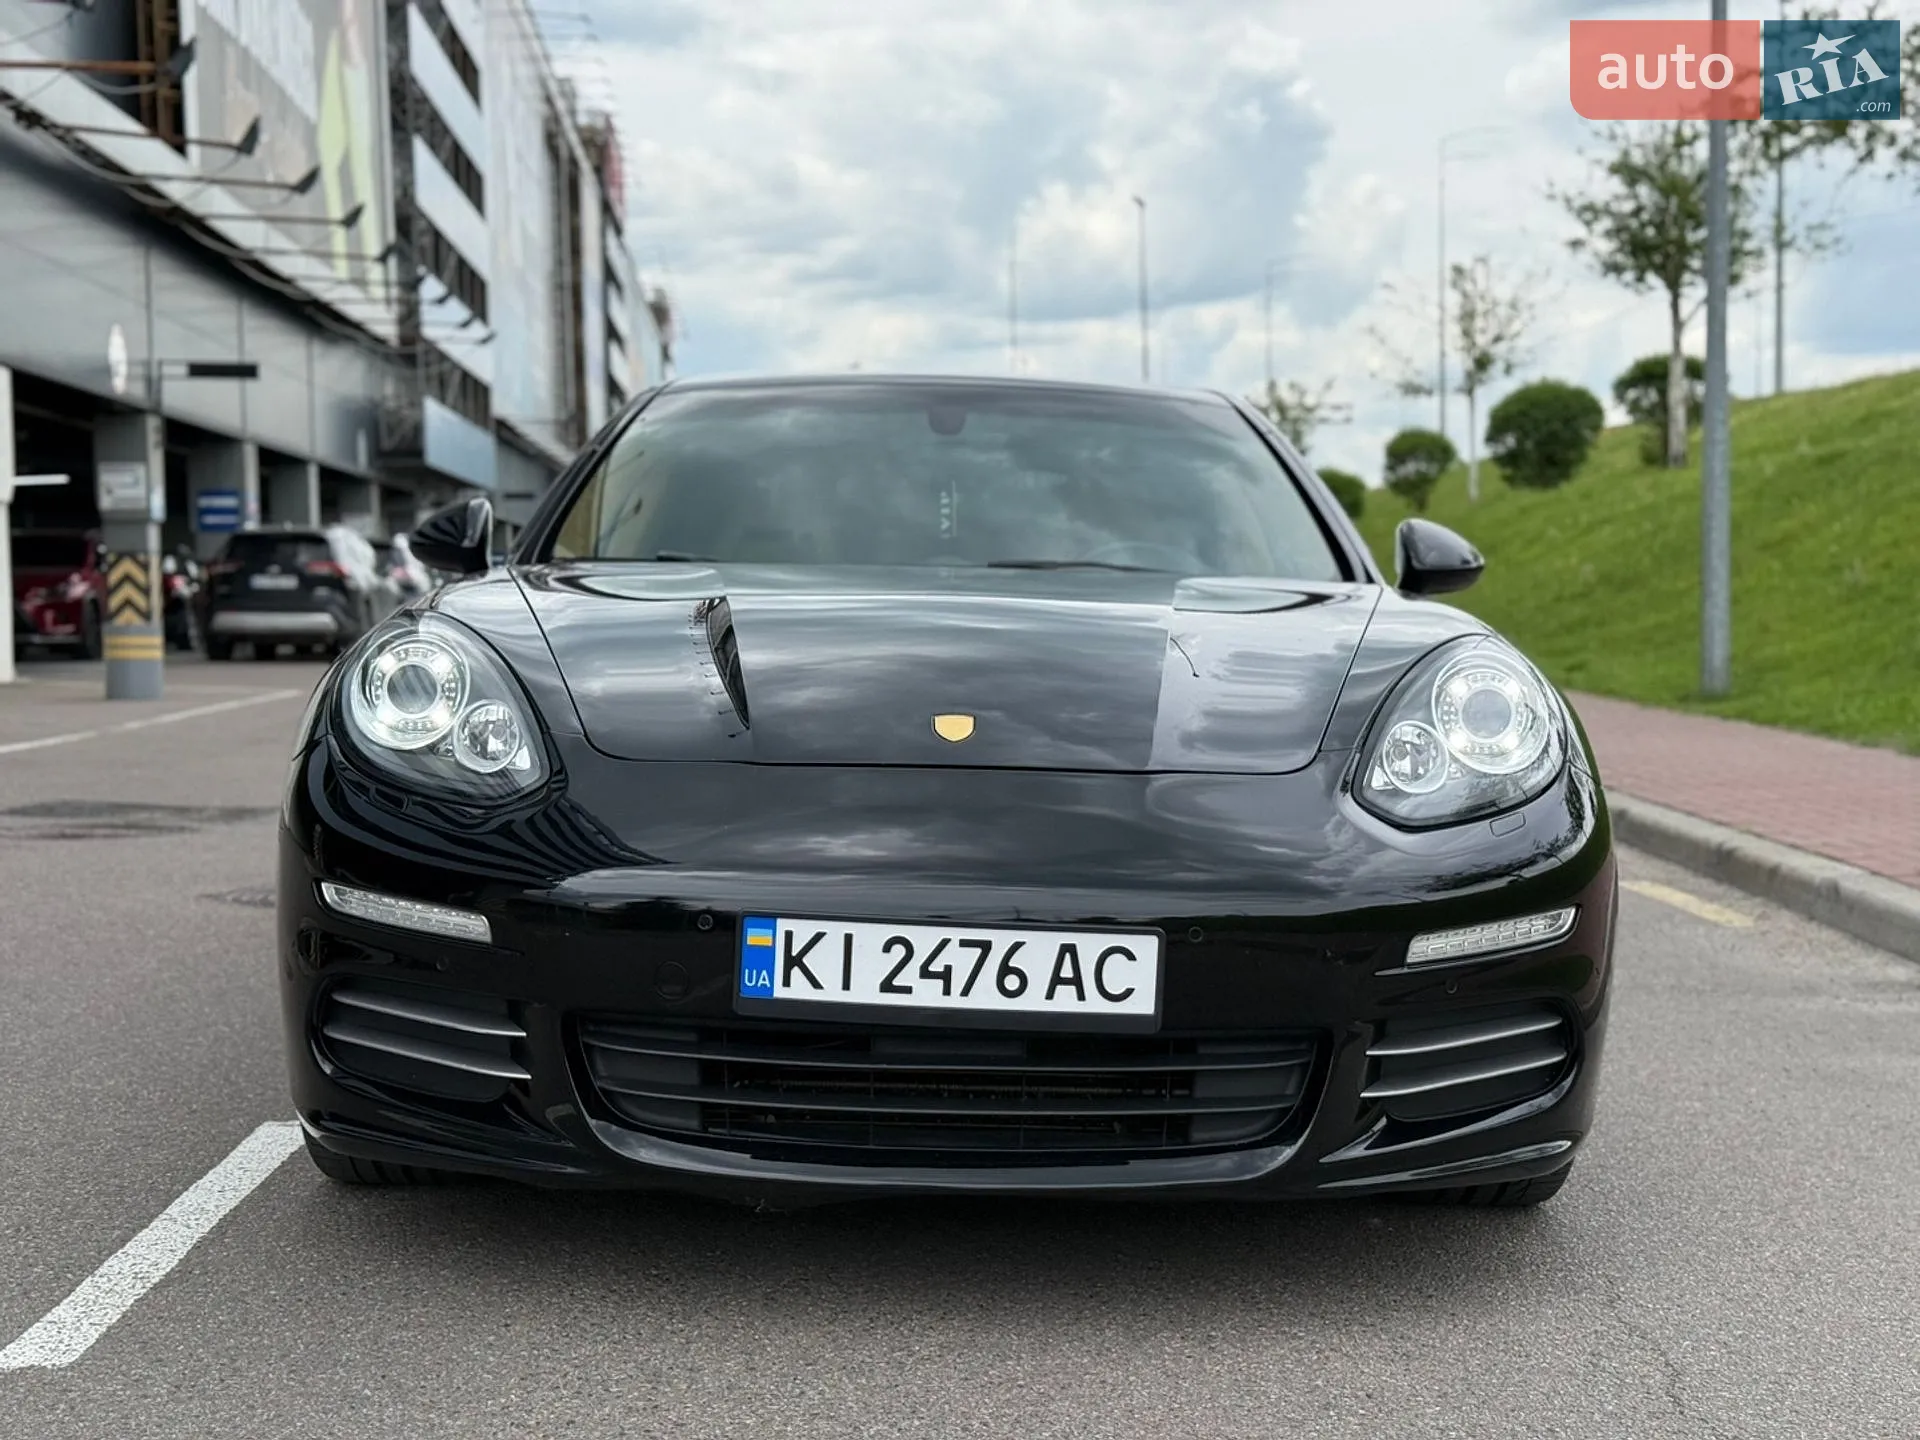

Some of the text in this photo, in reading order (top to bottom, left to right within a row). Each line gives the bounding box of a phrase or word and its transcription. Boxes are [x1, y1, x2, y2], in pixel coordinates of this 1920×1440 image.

[745, 969, 770, 988] UA
[782, 929, 1137, 1003] KI 2476 AC
